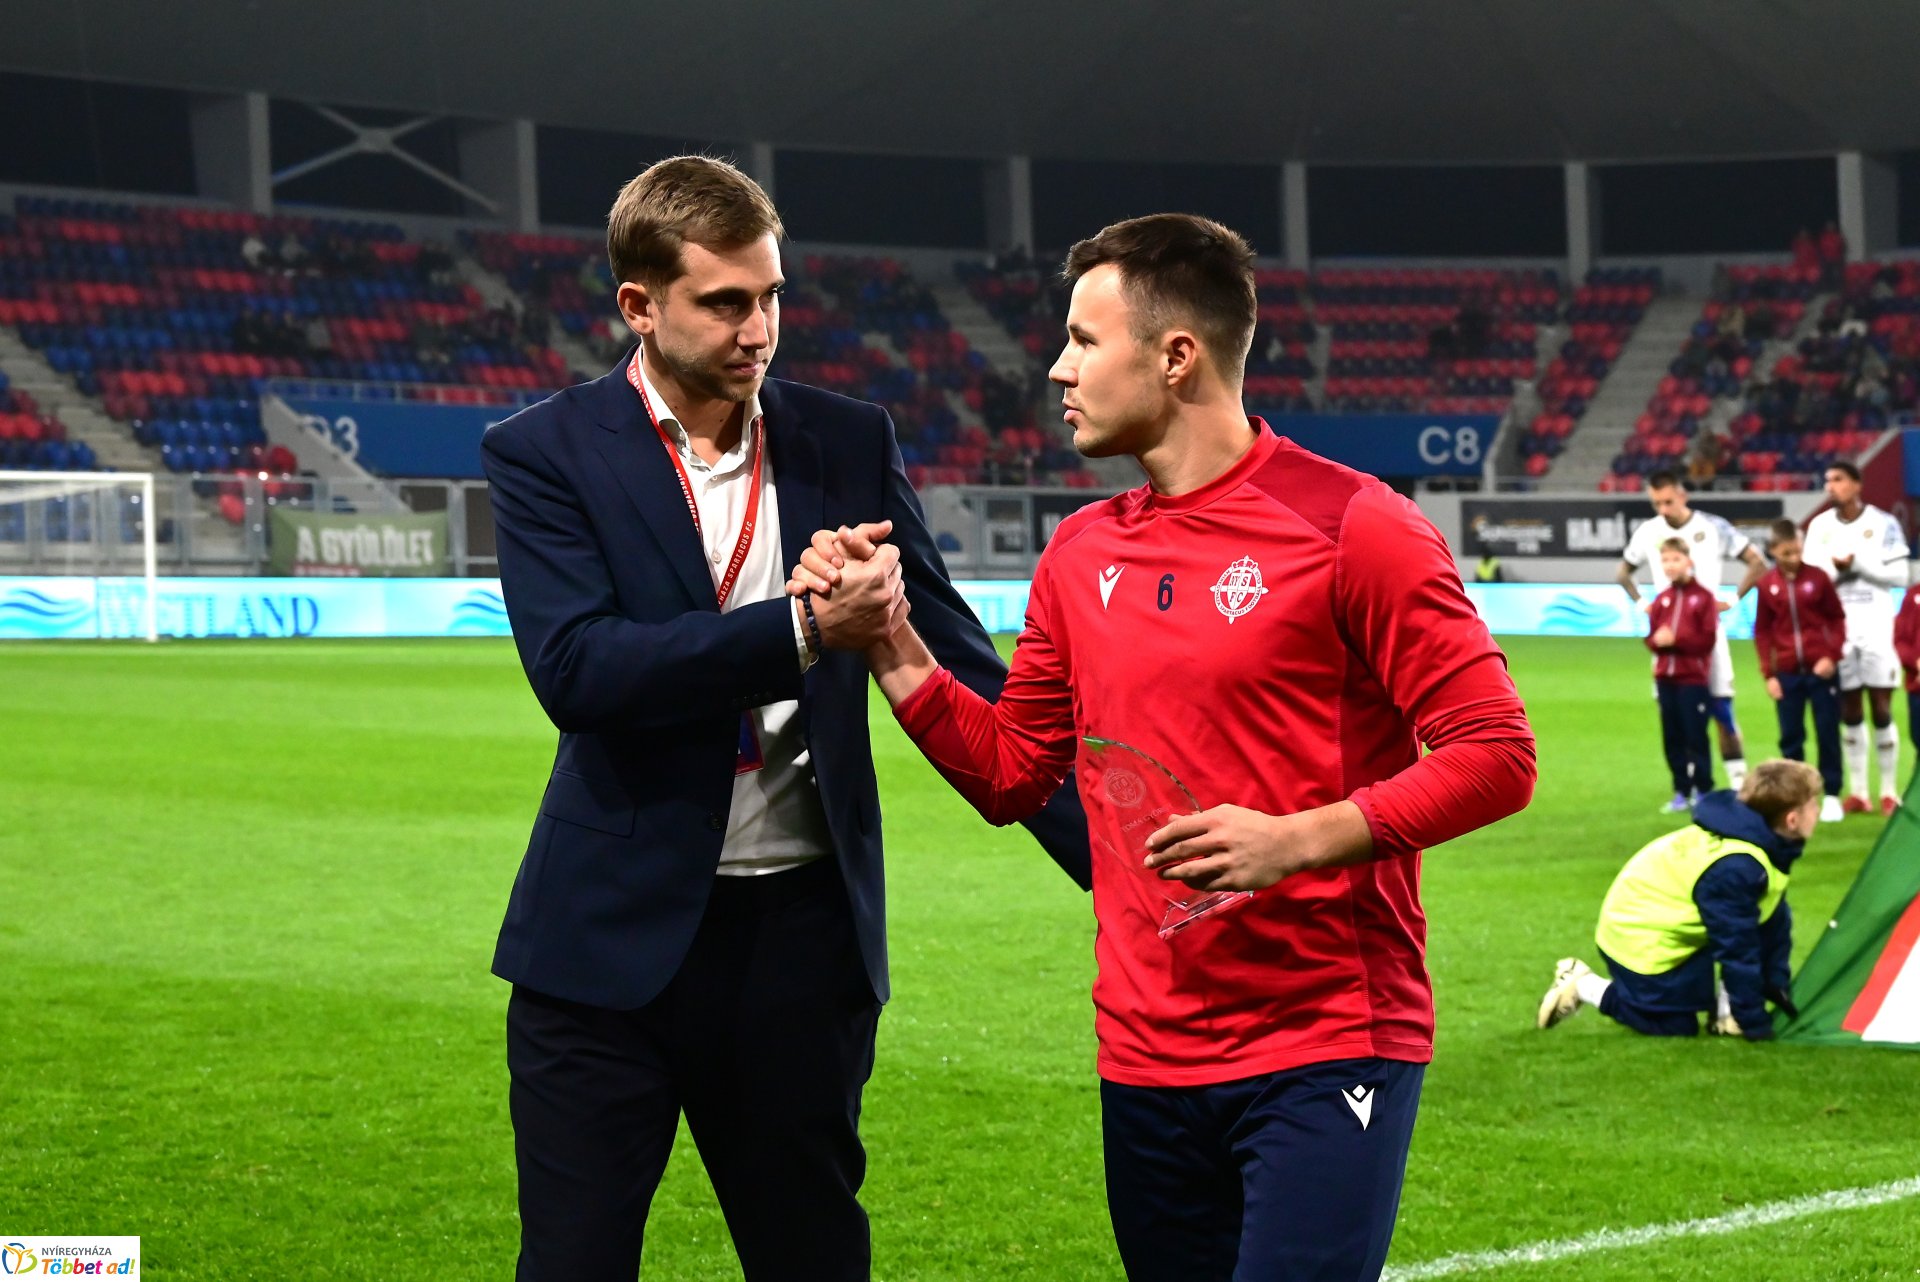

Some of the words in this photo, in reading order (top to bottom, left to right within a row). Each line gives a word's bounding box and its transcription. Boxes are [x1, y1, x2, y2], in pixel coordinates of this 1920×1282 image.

[1418, 425, 1480, 465] C8
[297, 526, 318, 562] A
[727, 533, 750, 579] SPARTACUS
[745, 520, 753, 532] FC
[98, 584, 319, 637] WETLAND
[1157, 573, 1175, 612] 6
